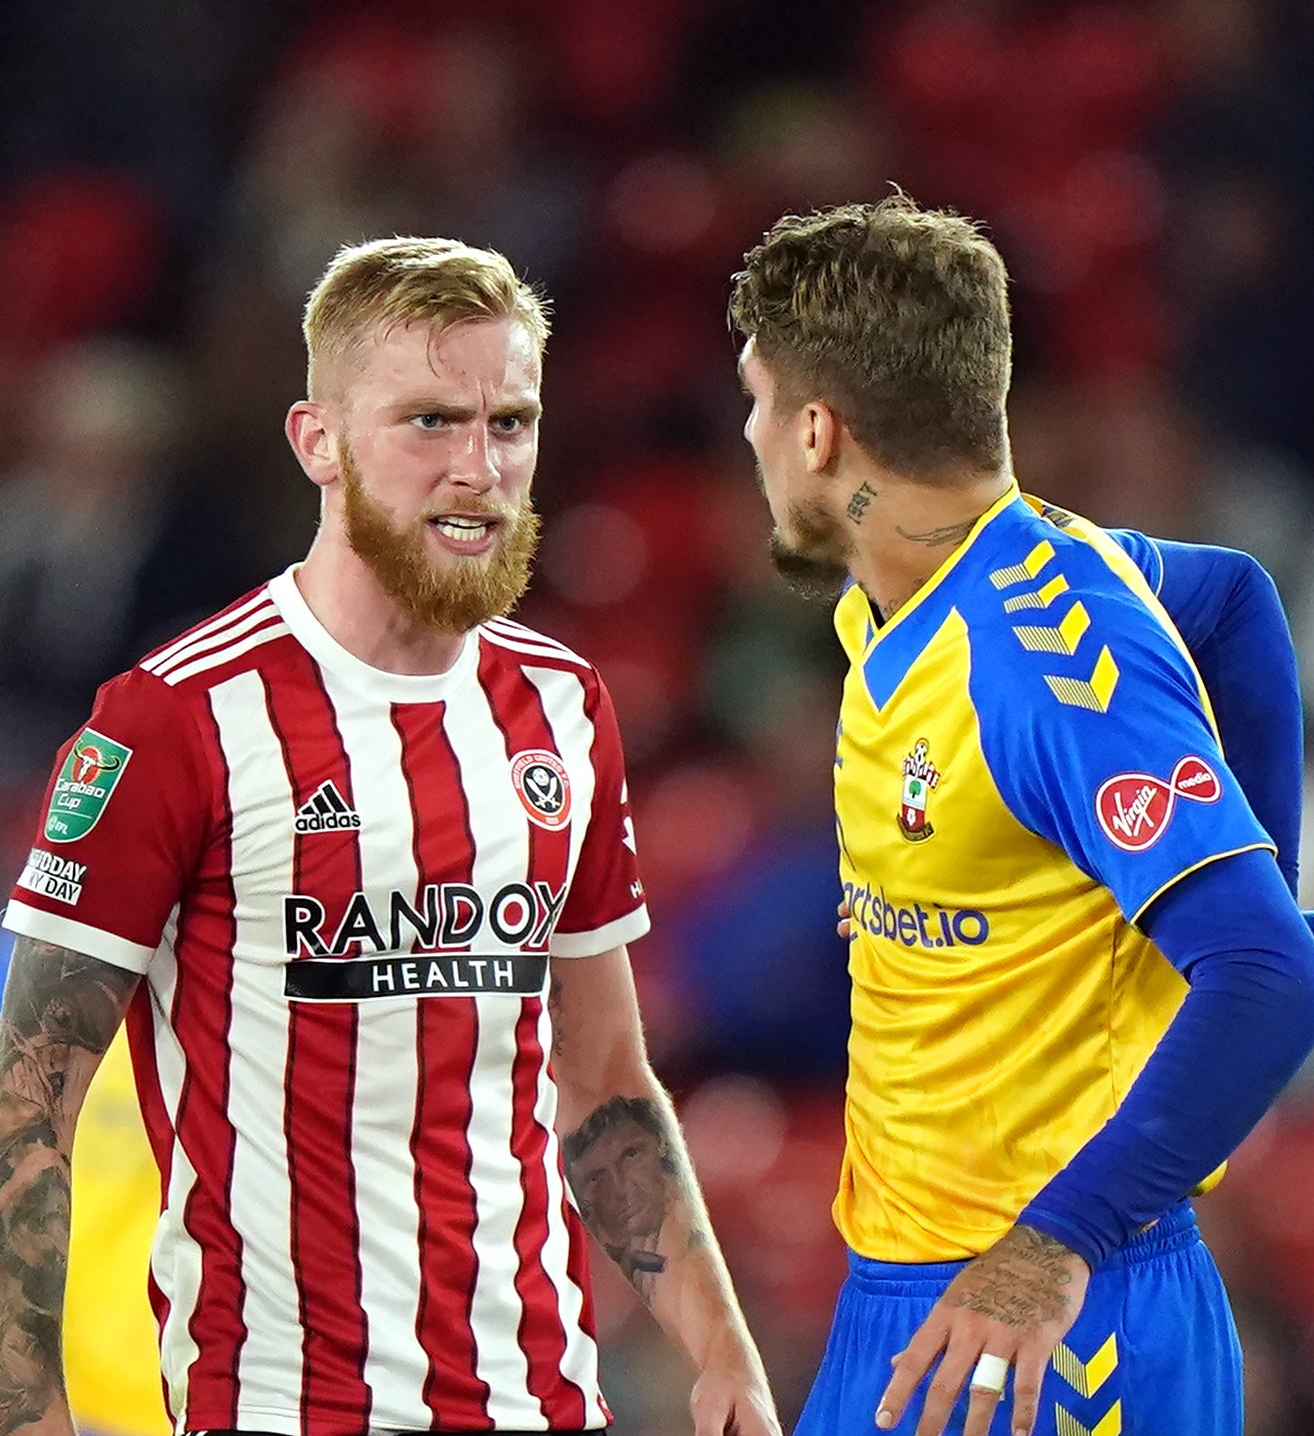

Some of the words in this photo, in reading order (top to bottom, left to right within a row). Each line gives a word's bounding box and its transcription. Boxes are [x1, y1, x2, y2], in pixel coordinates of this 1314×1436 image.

[55, 778, 106, 799] Carabao
[57, 793, 82, 810] Cup
[1112, 785, 1158, 837] Virgin
[1177, 772, 1212, 790] media
[295, 812, 362, 831] adidas
[45, 877, 79, 901] DAY
[284, 882, 567, 957] RANDOX
[372, 960, 514, 992] HEALTH
